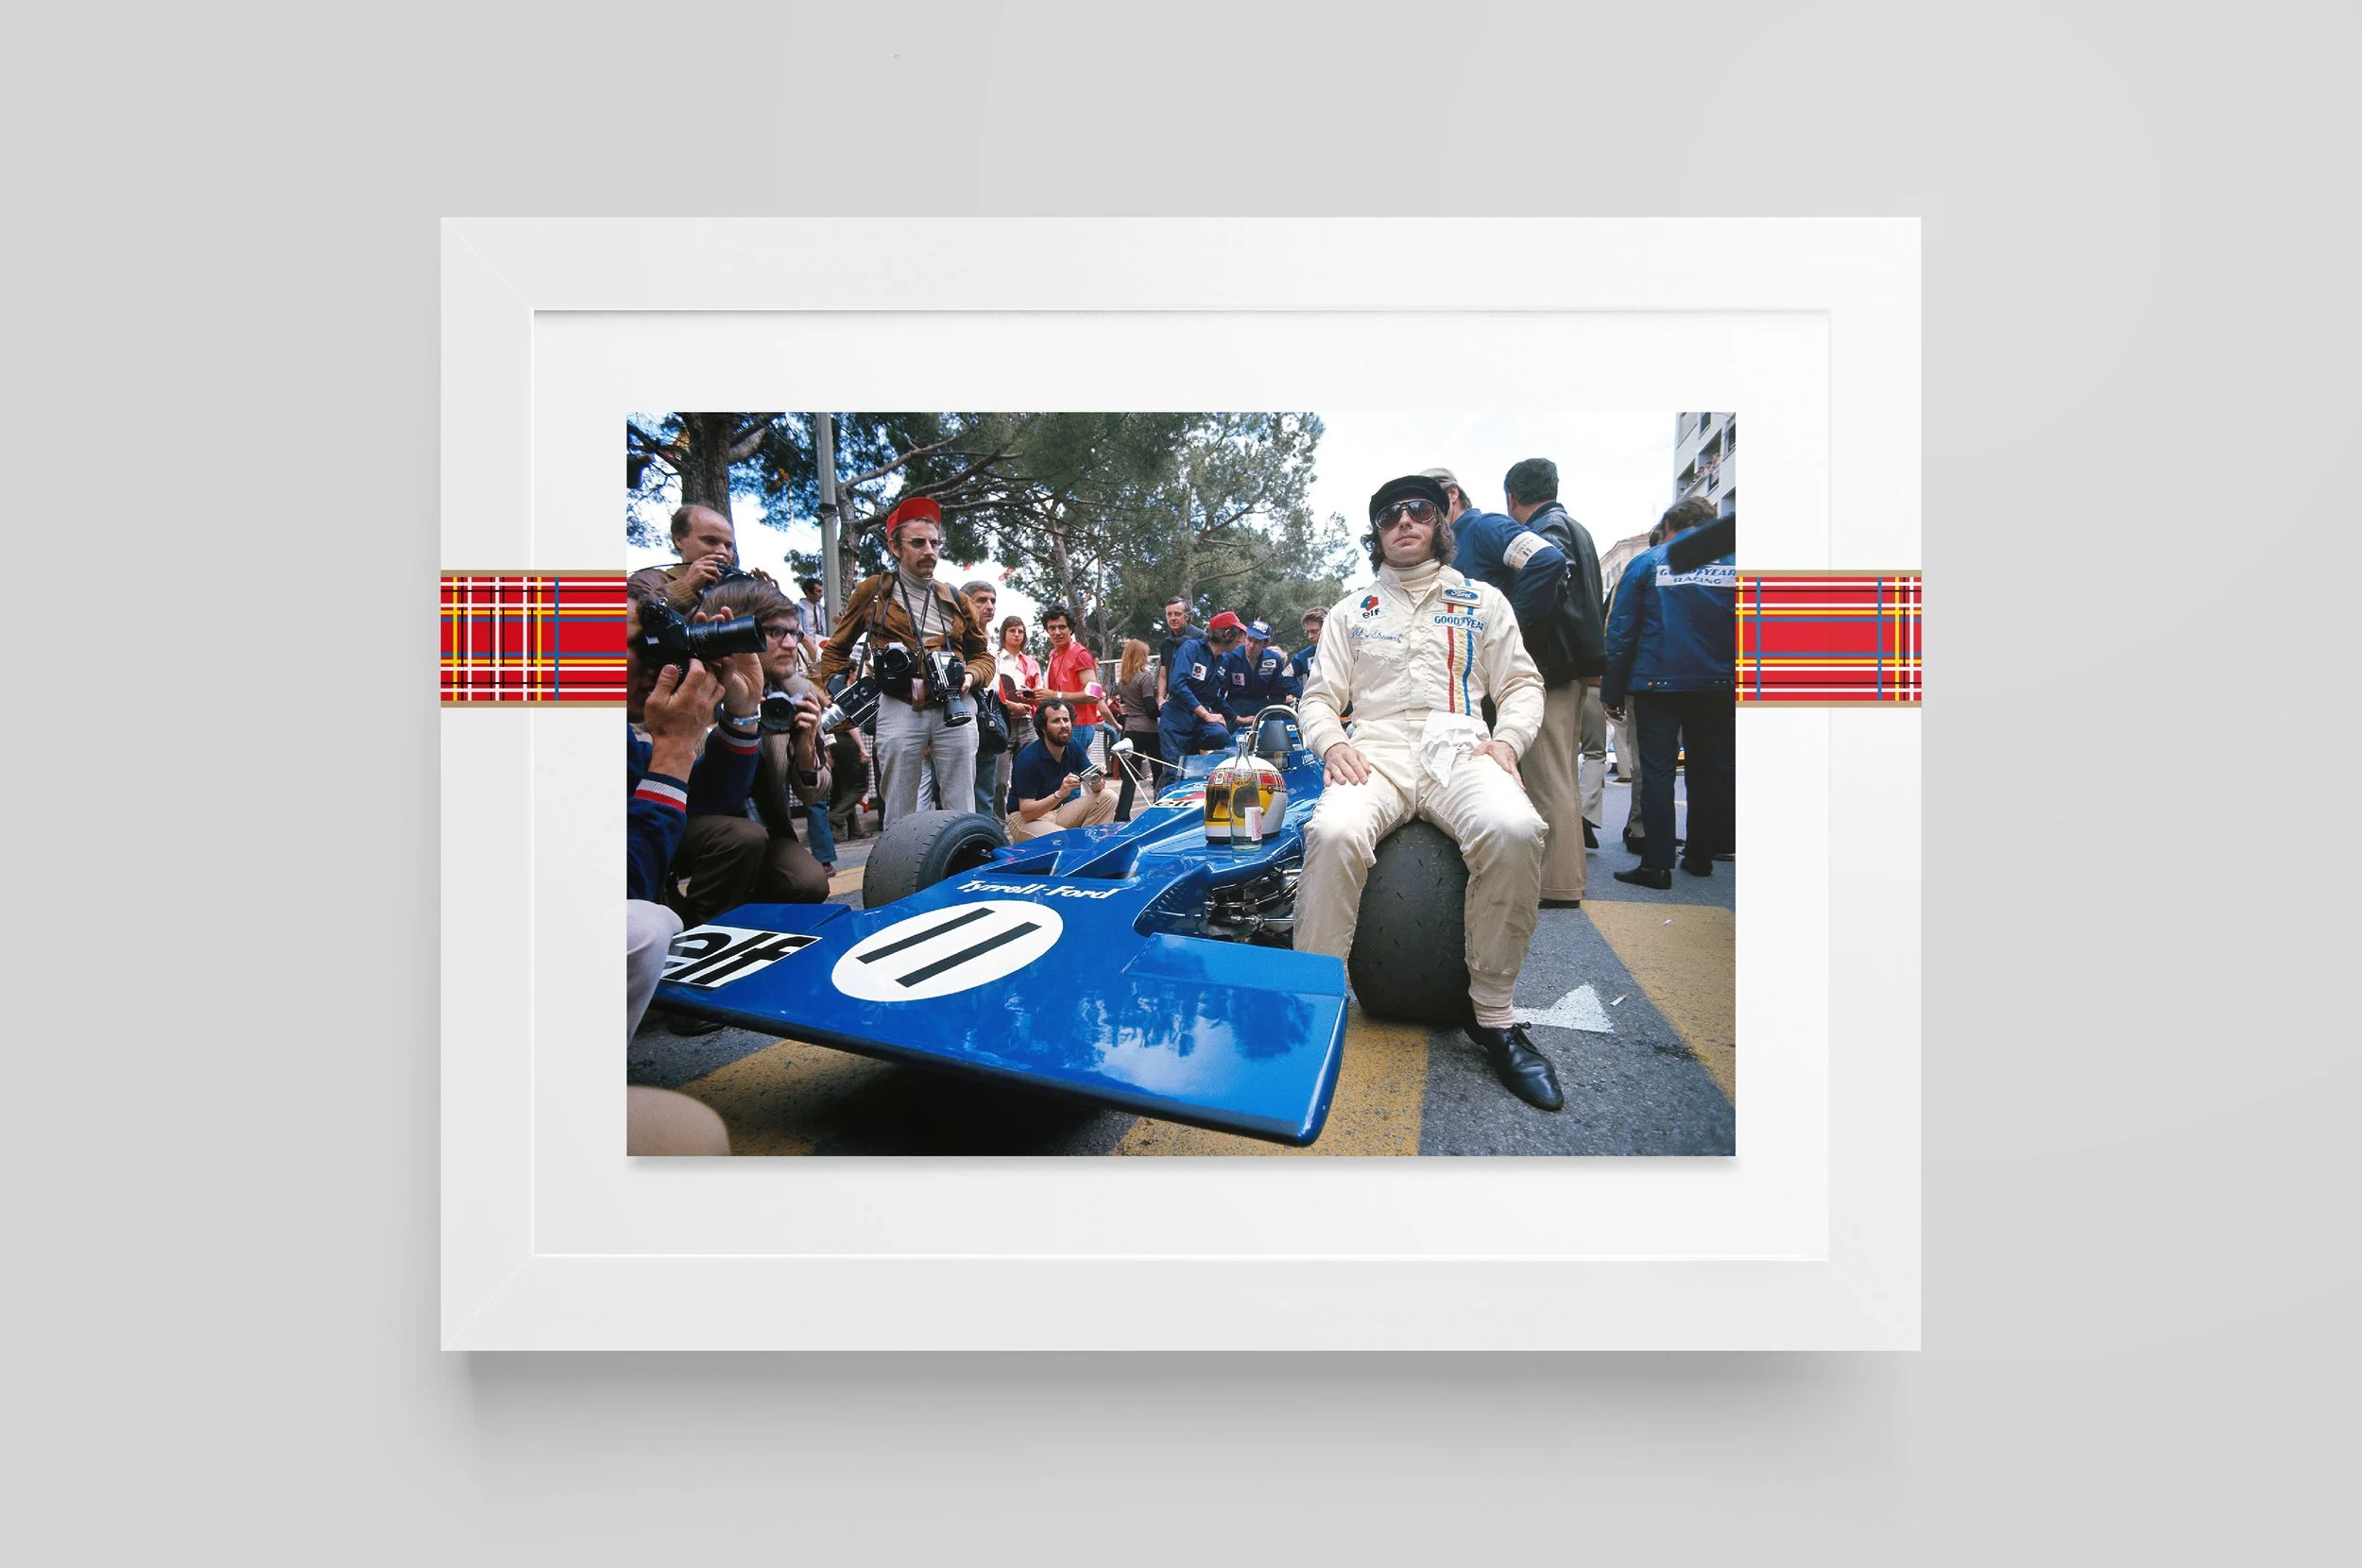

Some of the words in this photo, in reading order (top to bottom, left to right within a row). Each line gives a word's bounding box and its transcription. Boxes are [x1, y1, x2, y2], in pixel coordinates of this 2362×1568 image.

[1674, 576, 1721, 585] RACING
[1450, 590, 1472, 599] Ford
[1362, 608, 1379, 619] elf
[855, 907, 1042, 987] 11
